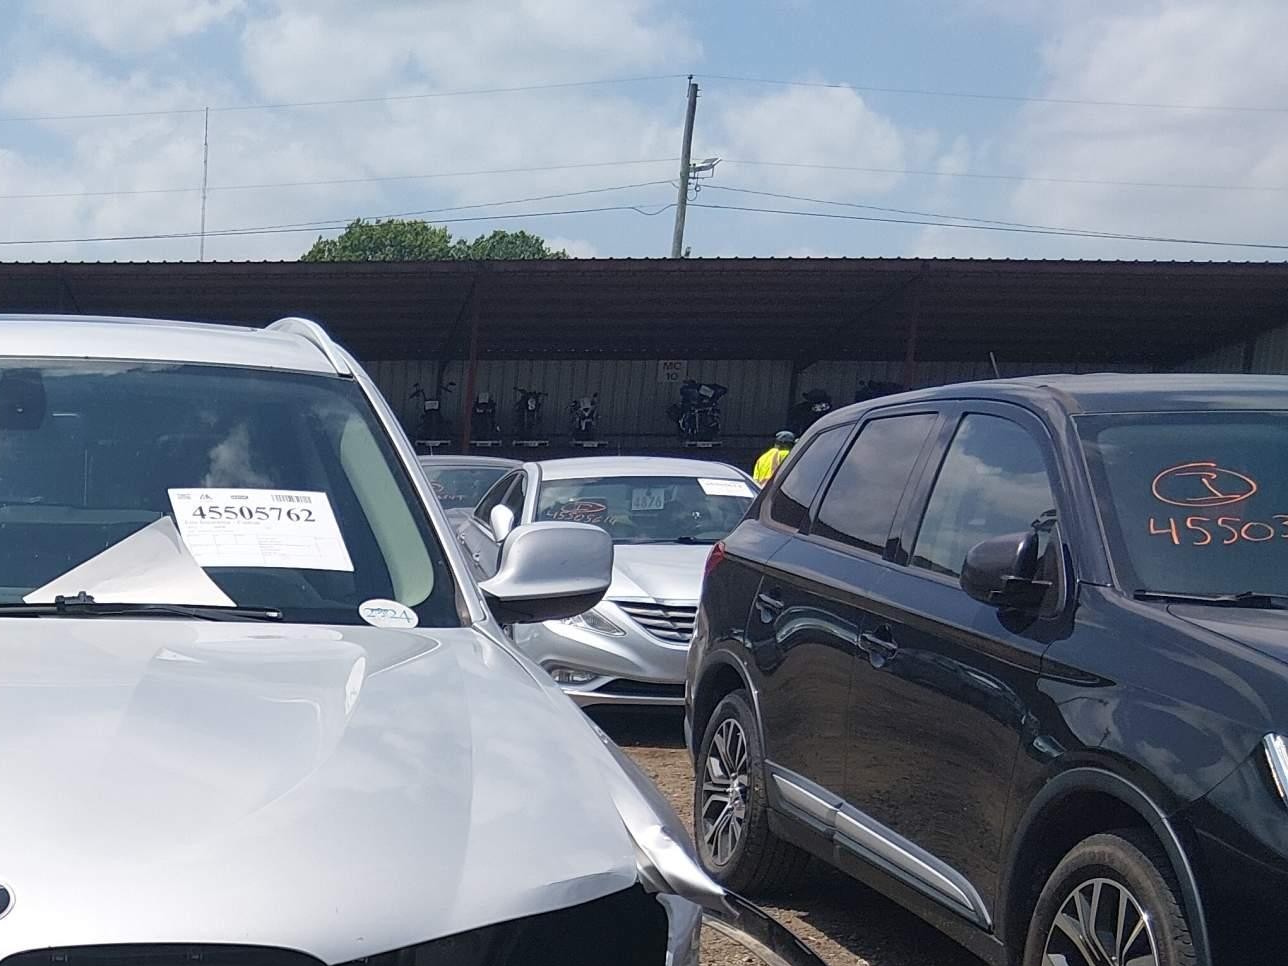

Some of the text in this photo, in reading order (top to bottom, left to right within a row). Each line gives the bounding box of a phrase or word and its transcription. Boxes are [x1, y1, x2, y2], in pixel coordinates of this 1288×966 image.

[664, 362, 681, 370] MC
[666, 372, 678, 380] 10
[192, 505, 316, 522] 45505762
